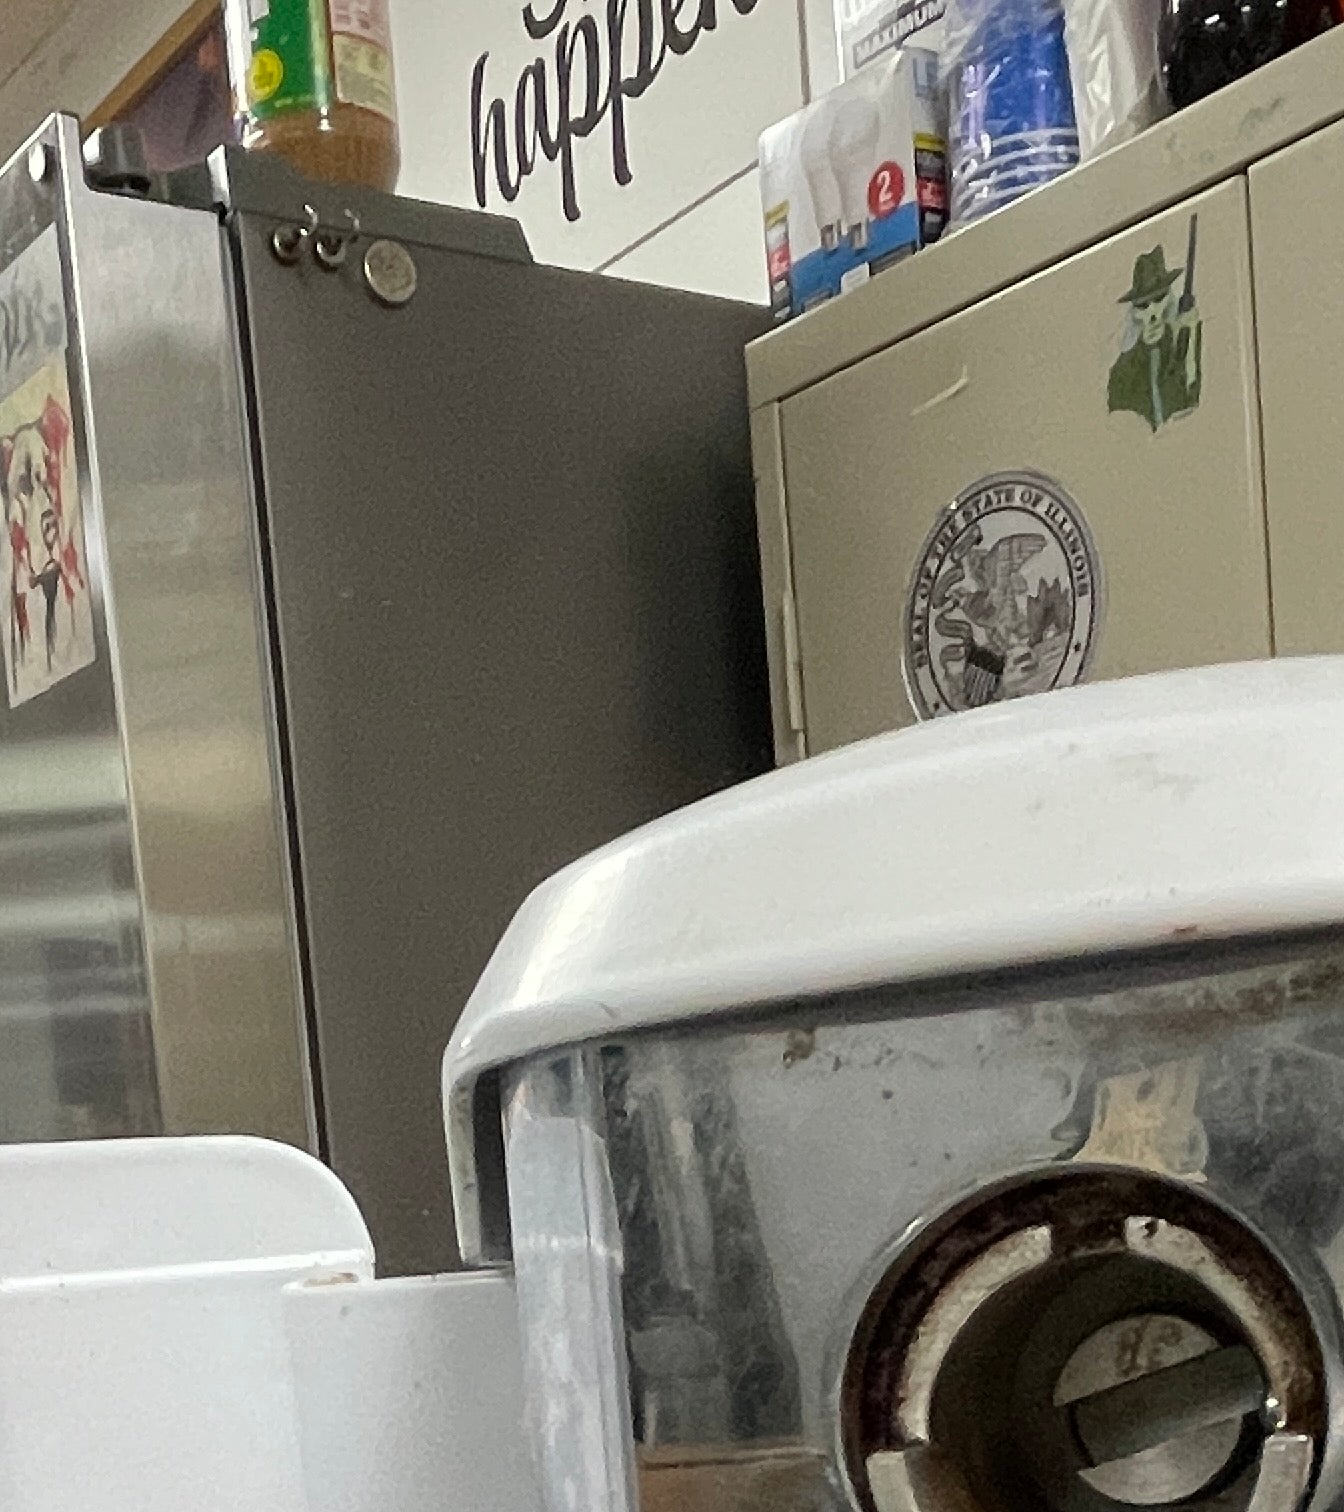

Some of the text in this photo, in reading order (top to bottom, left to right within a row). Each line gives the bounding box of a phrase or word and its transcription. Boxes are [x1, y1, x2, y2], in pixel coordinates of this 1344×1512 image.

[876, 170, 893, 202] 2
[961, 487, 1016, 521] STATE
[1020, 488, 1043, 508] OF
[1044, 502, 1089, 598] ILLINOIS
